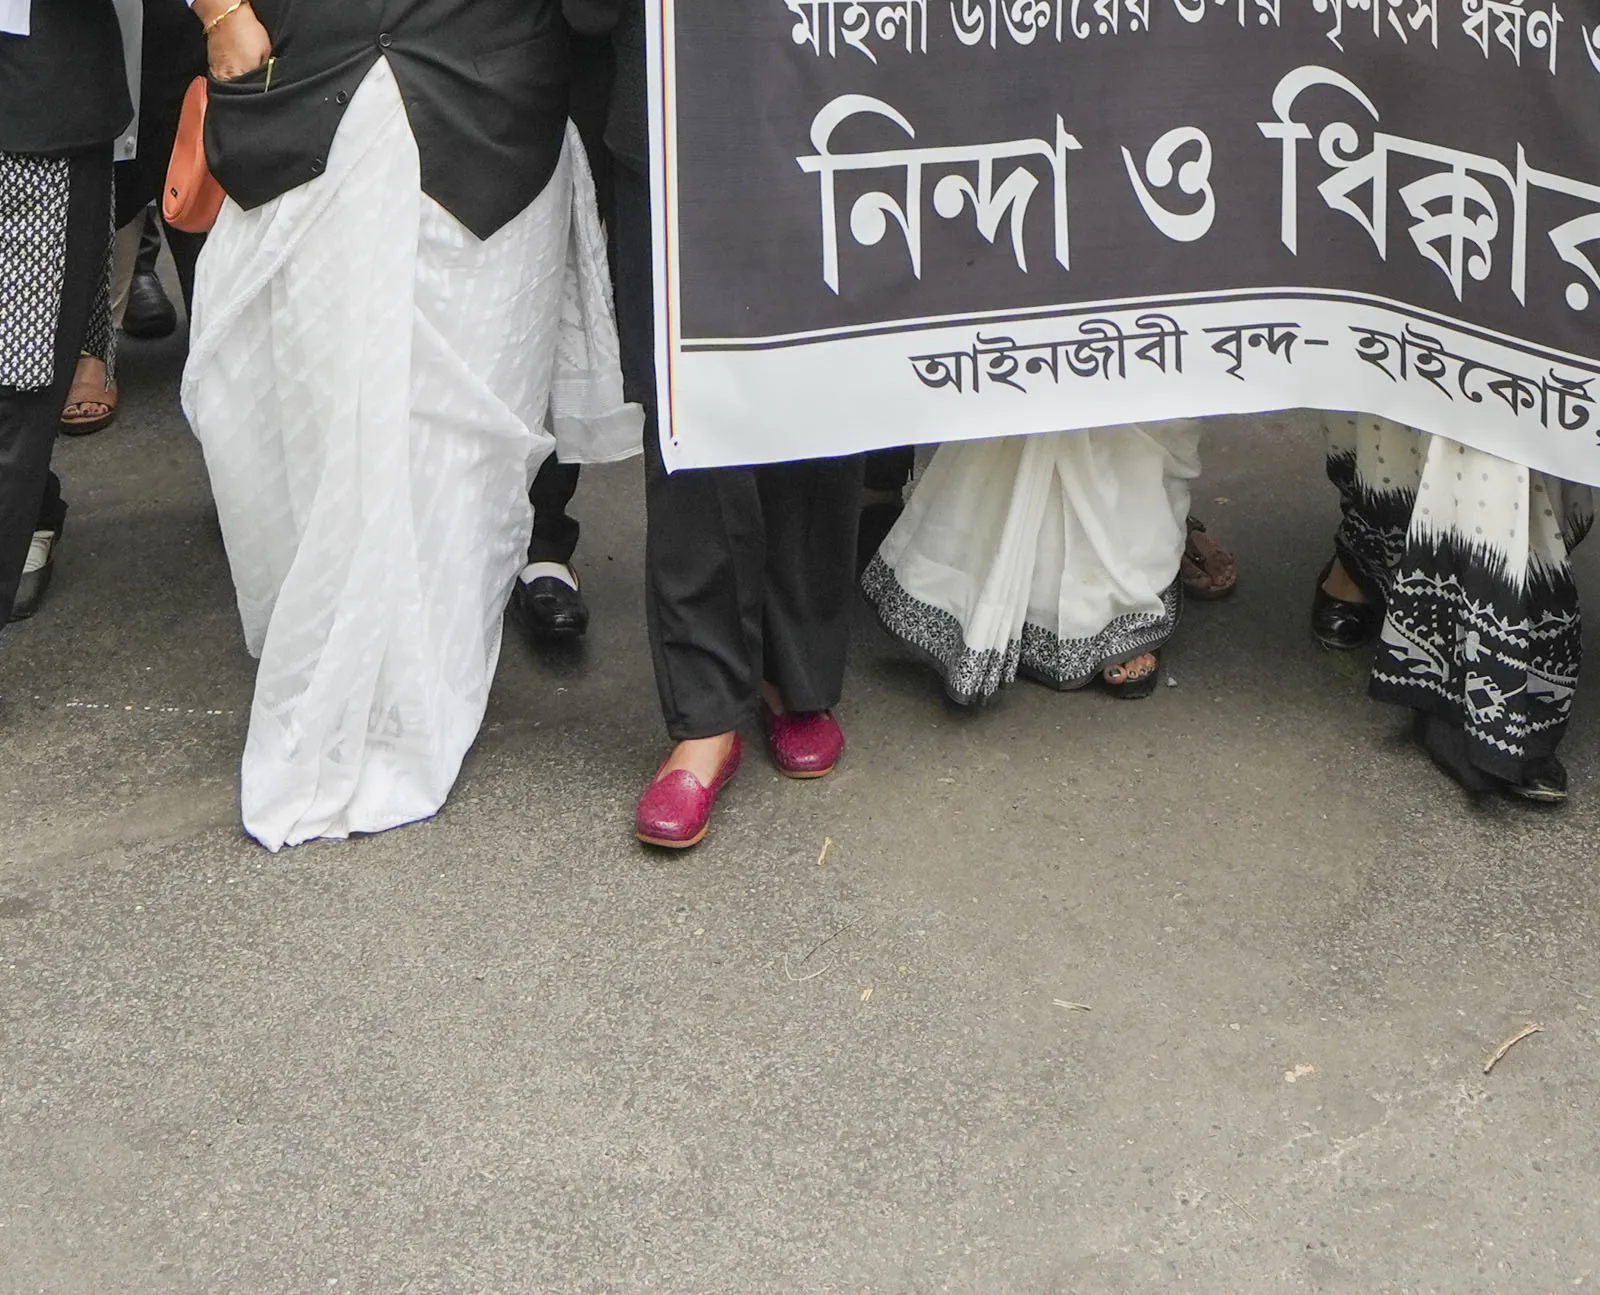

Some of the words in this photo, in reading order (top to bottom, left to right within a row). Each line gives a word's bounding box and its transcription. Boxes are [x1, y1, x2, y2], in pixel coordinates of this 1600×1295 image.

[796, 94, 1083, 295] নিন্দা
[1120, 126, 1216, 242] ও
[908, 314, 1189, 394] আইনজীবী
[1203, 321, 1329, 380] বৃন্দ-
